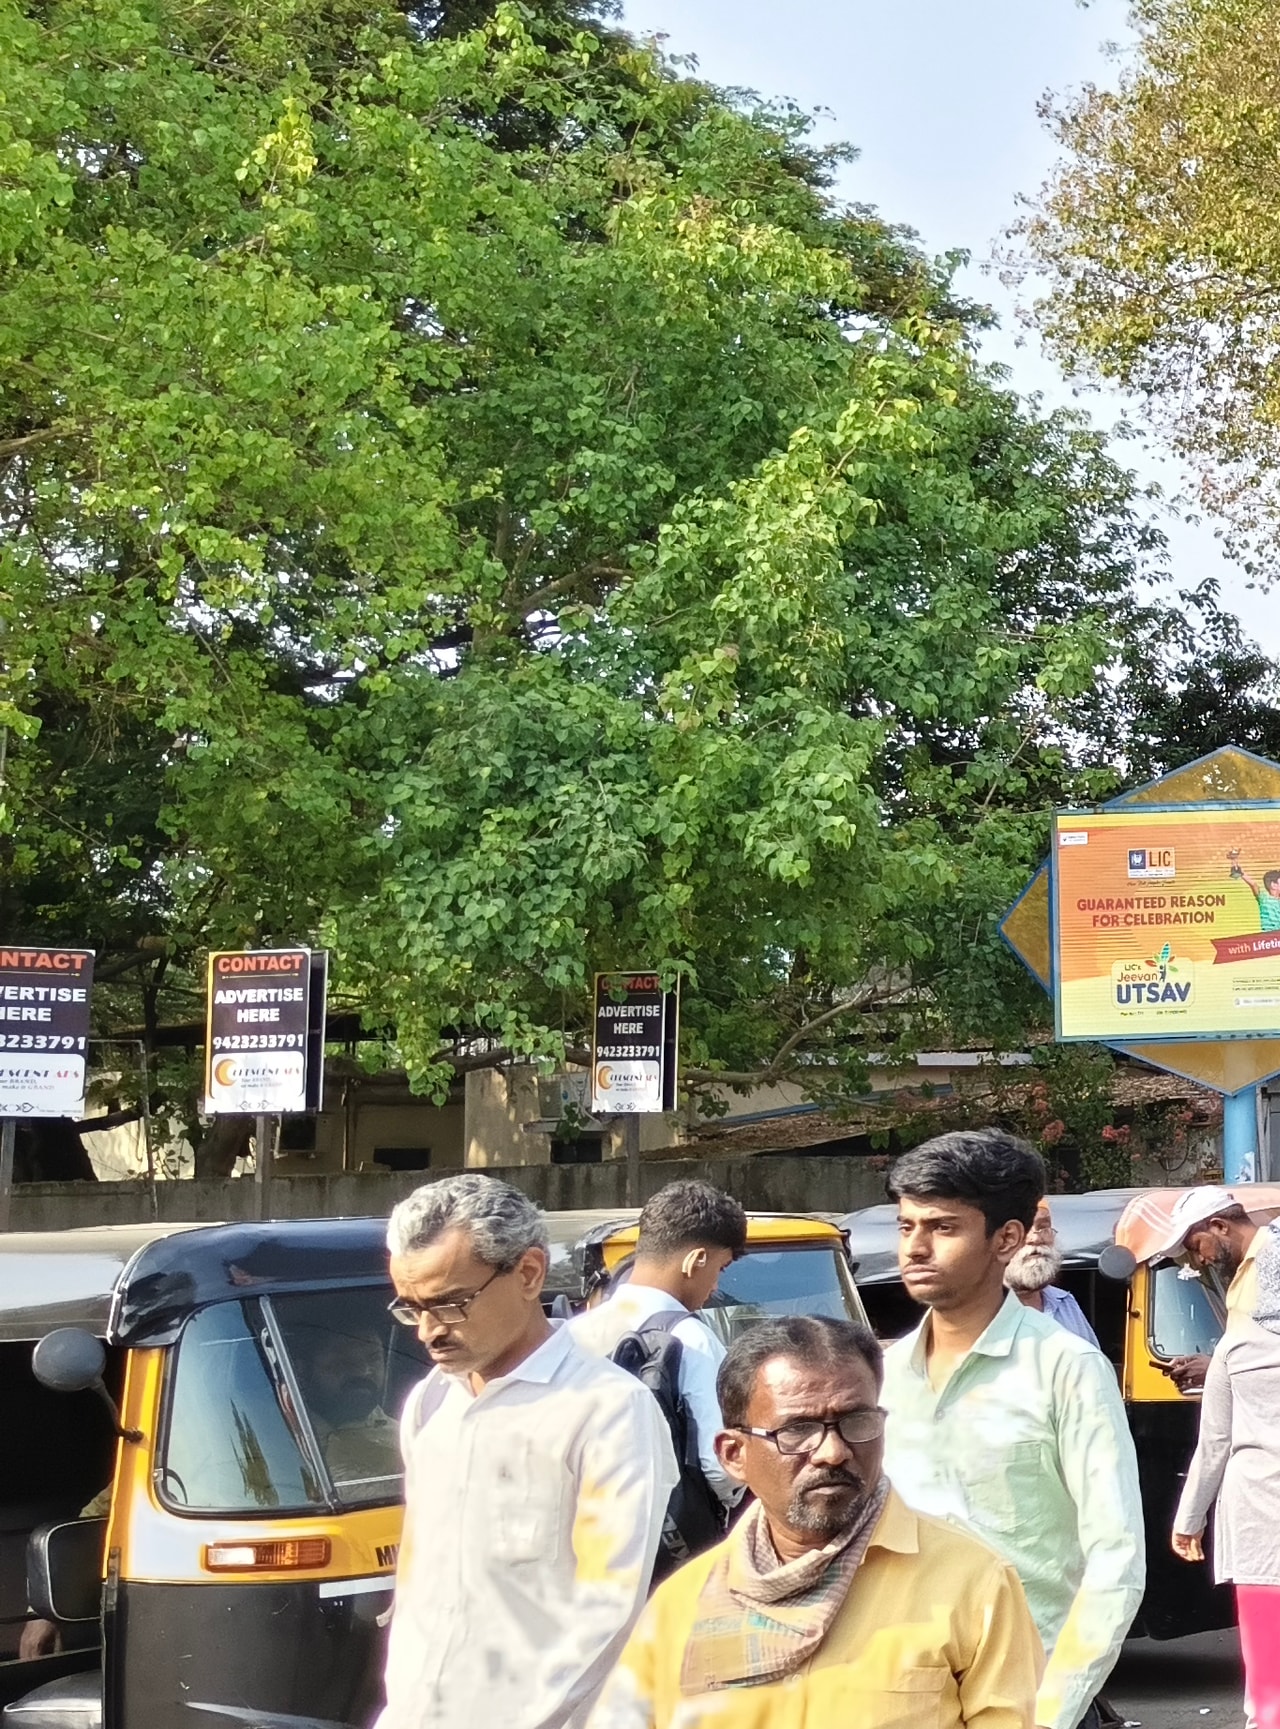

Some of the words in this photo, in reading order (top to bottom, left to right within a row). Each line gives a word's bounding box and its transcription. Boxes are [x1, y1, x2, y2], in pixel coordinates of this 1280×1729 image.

[1149, 850, 1171, 867] LIC
[1076, 896, 1166, 911] GUARANTEED
[1170, 894, 1226, 908] REASON
[1092, 914, 1120, 928] FOR
[1123, 911, 1215, 926] CELEBRATION
[1228, 943, 1251, 955] with
[218, 955, 304, 973] CONTACT
[1117, 972, 1158, 982] Jeevan
[214, 987, 304, 1004] ADVERTISE
[1116, 982, 1191, 1004] UTSAV
[236, 1008, 280, 1023] HERE
[598, 1005, 660, 1018] ADVERTISE
[613, 1022, 644, 1034] HERE
[213, 1034, 304, 1050] 9423233791
[597, 1045, 660, 1058] 9423233791
